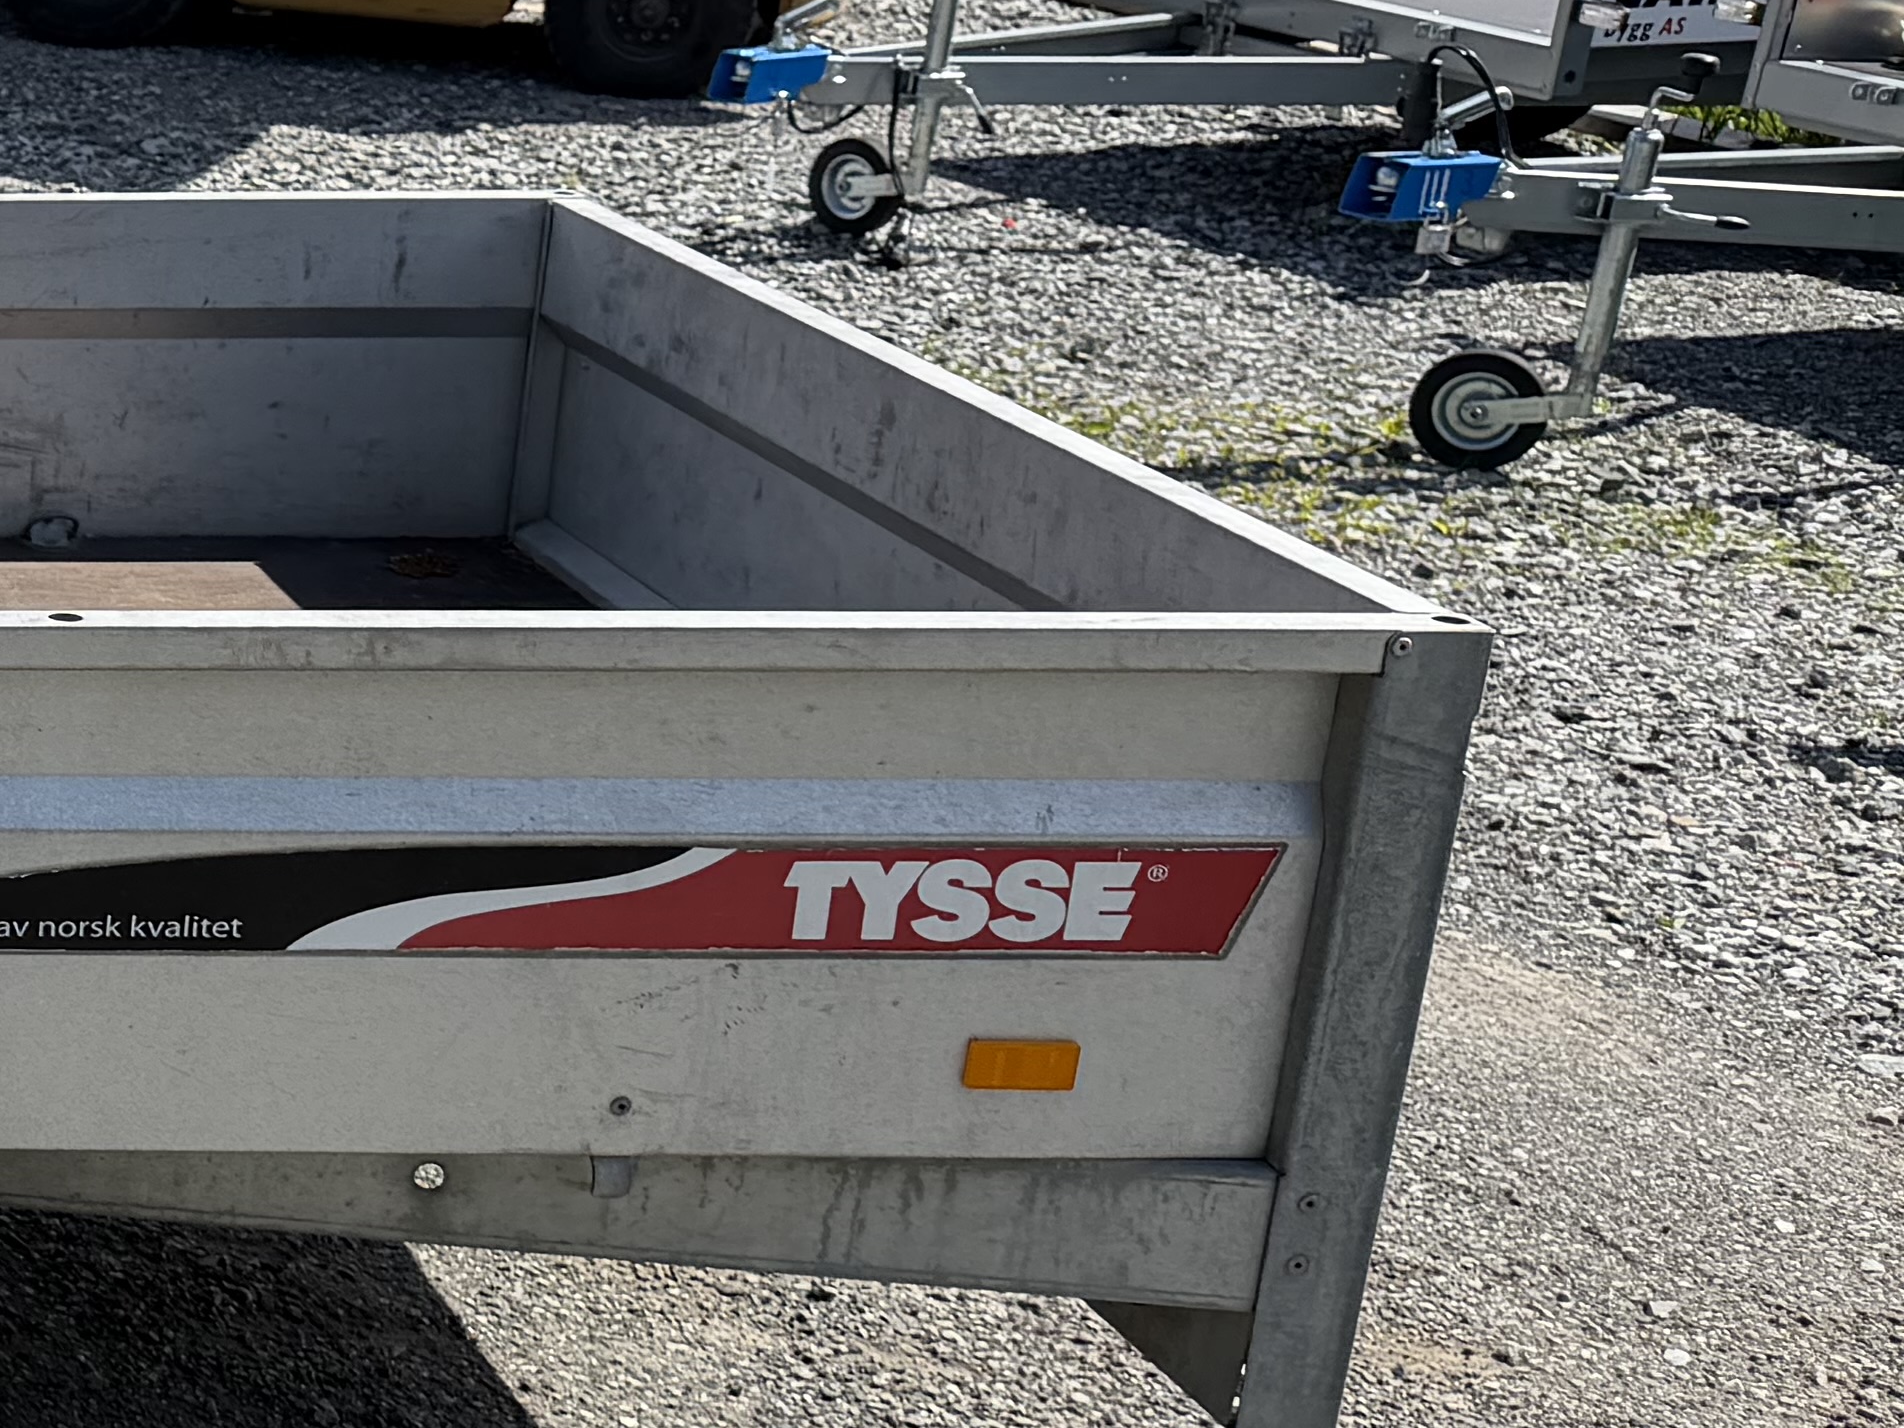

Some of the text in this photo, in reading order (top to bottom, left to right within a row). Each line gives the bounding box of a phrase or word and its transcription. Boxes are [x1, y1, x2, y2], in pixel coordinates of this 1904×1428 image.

[1658, 17, 1687, 36] AS
[38, 914, 122, 939] norsk
[130, 914, 244, 939] kvalitet
